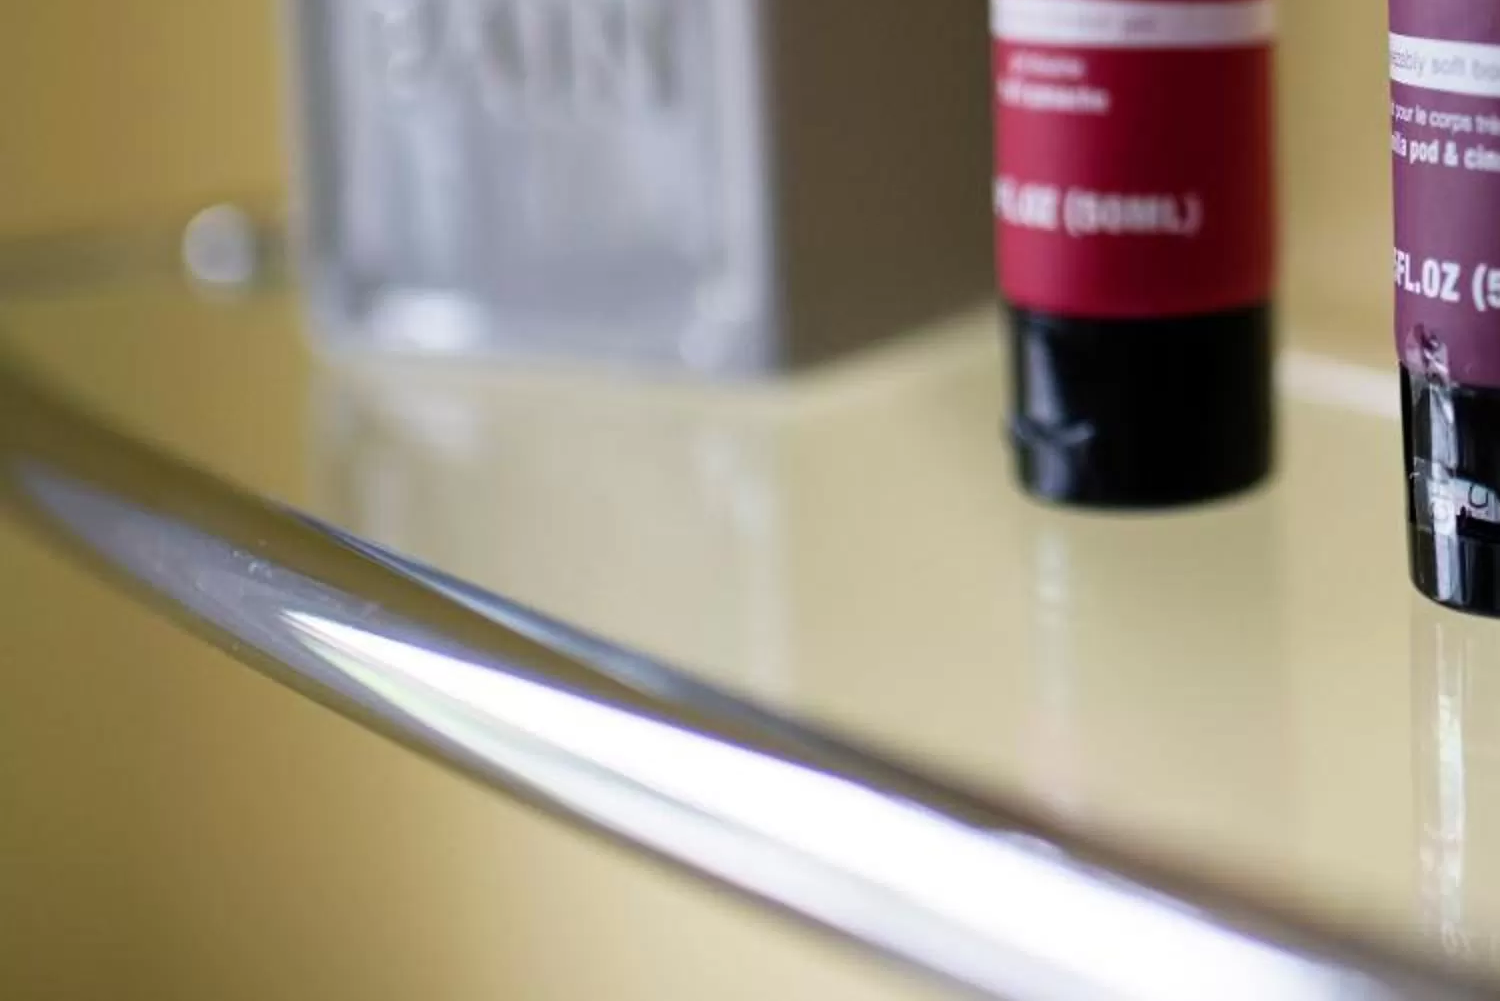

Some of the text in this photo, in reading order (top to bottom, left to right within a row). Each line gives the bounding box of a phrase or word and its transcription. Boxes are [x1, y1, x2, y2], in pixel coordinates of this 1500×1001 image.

[1431, 55, 1467, 76] soft
[1415, 104, 1428, 126] le
[1429, 110, 1473, 137] corps
[1409, 139, 1439, 165] pod
[1443, 141, 1459, 167] &
